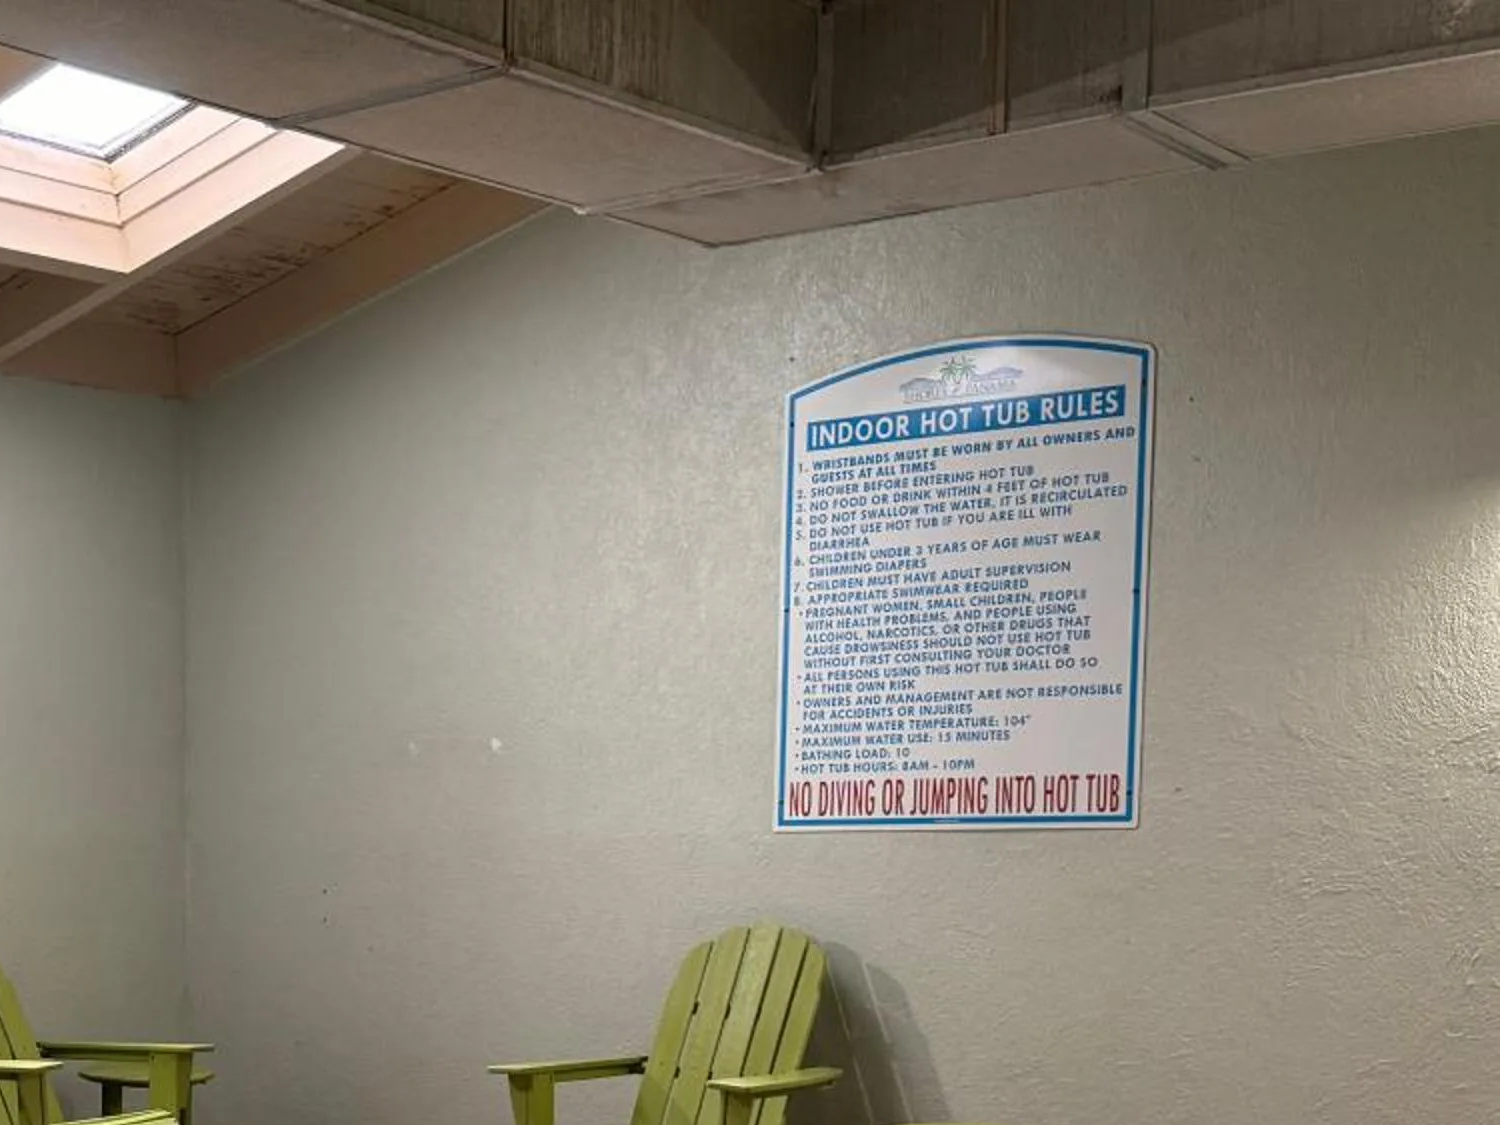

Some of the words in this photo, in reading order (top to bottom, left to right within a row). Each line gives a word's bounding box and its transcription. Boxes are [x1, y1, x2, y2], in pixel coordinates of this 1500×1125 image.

[809, 414, 910, 447] INDOOR
[919, 406, 973, 435] HOT
[980, 400, 1030, 428] TUB
[1039, 389, 1118, 421] RULES
[811, 452, 889, 471] WRISTBANDS
[893, 448, 928, 463] MUST
[931, 446, 947, 458] BE
[950, 441, 992, 456] WORN
[995, 439, 1012, 452] BY
[1016, 436, 1038, 449] ALL
[1041, 429, 1101, 446] OWNERS
[1104, 425, 1135, 440] AND
[810, 469, 854, 484] GUESTS
[857, 467, 872, 479] AT
[875, 465, 896, 477] ALL
[899, 460, 936, 475] TIMES
[810, 482, 859, 498] SHOWER
[862, 477, 908, 492] BEFORE
[912, 470, 974, 487] ENTERING
[978, 467, 1005, 481] HOT
[1009, 464, 1034, 477] TUB
[808, 499, 829, 511] NO
[832, 495, 867, 509] FOOD
[870, 493, 888, 505] OR
[892, 489, 931, 503] DRINK
[935, 484, 981, 499] WITHIN
[996, 479, 1025, 493] FEET
[1028, 477, 1047, 490] OF
[1051, 474, 1079, 488] HOT
[1084, 471, 1109, 484] TUB
[808, 512, 828, 525] DO
[830, 510, 856, 523] NOT
[860, 504, 919, 520] SWALLOW
[923, 501, 945, 514] THE
[999, 495, 1011, 507] IT
[1014, 493, 1026, 506] IS
[1030, 483, 1128, 504] RECIRCULATED
[808, 526, 827, 539] DO
[830, 524, 855, 537] NOT
[859, 521, 882, 534] USE
[884, 518, 910, 532] HOT
[915, 516, 938, 529] TUB
[941, 515, 952, 527] IF
[957, 512, 985, 525] YOU
[988, 509, 1014, 522] ARE
[1017, 507, 1035, 520] ILL
[1038, 503, 1072, 518] WITH
[808, 536, 870, 551] DIARRHEA
[808, 549, 866, 565] CHILDREN
[869, 545, 911, 560] UNDER
[926, 541, 967, 555] YEARS
[970, 539, 988, 551] OF
[991, 536, 1018, 550] AGE
[1022, 533, 1058, 547] MUST
[1062, 529, 1101, 544] WEAR
[805, 576, 863, 591] CHILDREN
[866, 573, 899, 587] MUST
[903, 570, 936, 584] HAVE
[940, 567, 981, 581] ADULT
[985, 560, 1071, 578] SUPERVISION
[808, 562, 872, 578] SWIMMING
[875, 557, 927, 572] DIAPERS
[804, 603, 868, 618] PREGNANT
[926, 596, 965, 610] SMALL
[1038, 588, 1087, 602] PEOPLE
[807, 588, 888, 604] APPROPRIATE
[891, 583, 959, 598] SWIMWEAR
[964, 578, 1029, 593] REQUIRED
[804, 619, 833, 631] WITH
[836, 615, 881, 629] HEALTH
[953, 608, 981, 621] AND
[985, 605, 1032, 619] PEOPLE
[1035, 602, 1077, 616] USING
[941, 623, 960, 635] OR
[963, 620, 1005, 634] OTHER
[1008, 617, 1052, 631] DRUGS
[1057, 615, 1090, 628] THAT
[803, 644, 840, 656] CAUSE
[922, 636, 972, 649] SHOULD
[975, 634, 1003, 646] NOT
[1006, 632, 1030, 644] USE
[1034, 630, 1061, 642] HOT
[1066, 628, 1091, 641] TUB
[803, 655, 855, 669] WITHOUT
[859, 653, 890, 666] FIRST
[893, 649, 972, 664] CONSULTING
[976, 646, 1011, 659] YOUR
[1015, 643, 1070, 657] DOCTOR
[803, 671, 823, 682] ALL
[826, 668, 879, 681] PERSONS
[882, 665, 921, 678] USING
[924, 664, 950, 676] THIS
[954, 662, 980, 674] HOT
[984, 661, 1009, 673] TUB
[1012, 658, 1050, 671] SHALL
[1054, 657, 1075, 669] DO
[1079, 656, 1098, 668] SO
[802, 684, 817, 695] AT
[821, 682, 852, 694] THEIR
[855, 681, 885, 692] OWN
[888, 679, 915, 690] RISK
[802, 695, 851, 708] OWNERS
[855, 694, 881, 706] AND
[884, 690, 973, 704] MANAGEMENT
[976, 688, 1002, 700] ARE
[1005, 687, 1033, 699] NOT
[1036, 682, 1122, 697] RESPONSIBLE
[802, 709, 825, 721] FOR
[829, 706, 893, 720] ACCIDENTS
[896, 705, 915, 717] OR
[918, 703, 973, 716] INJURIES
[802, 721, 862, 734] MAXIMUM
[865, 719, 904, 731] WATER
[908, 716, 999, 730] TEMPERATURE:
[801, 735, 861, 747] MAXIMUM
[864, 733, 903, 745] WATER
[937, 731, 951, 742] 15
[955, 729, 1010, 742] MINUTES
[800, 749, 851, 761] BATHING
[895, 747, 910, 758] 10
[800, 763, 824, 774] HOT
[828, 762, 850, 773] TUB
[942, 758, 975, 770] 10PM
[788, 780, 812, 817] NO
[817, 779, 876, 816] DIVING
[880, 778, 905, 815] OR
[911, 776, 988, 815] JUMPING
[994, 775, 1036, 813] INTO
[1042, 774, 1078, 813] HOT
[1085, 773, 1120, 812] TUB
